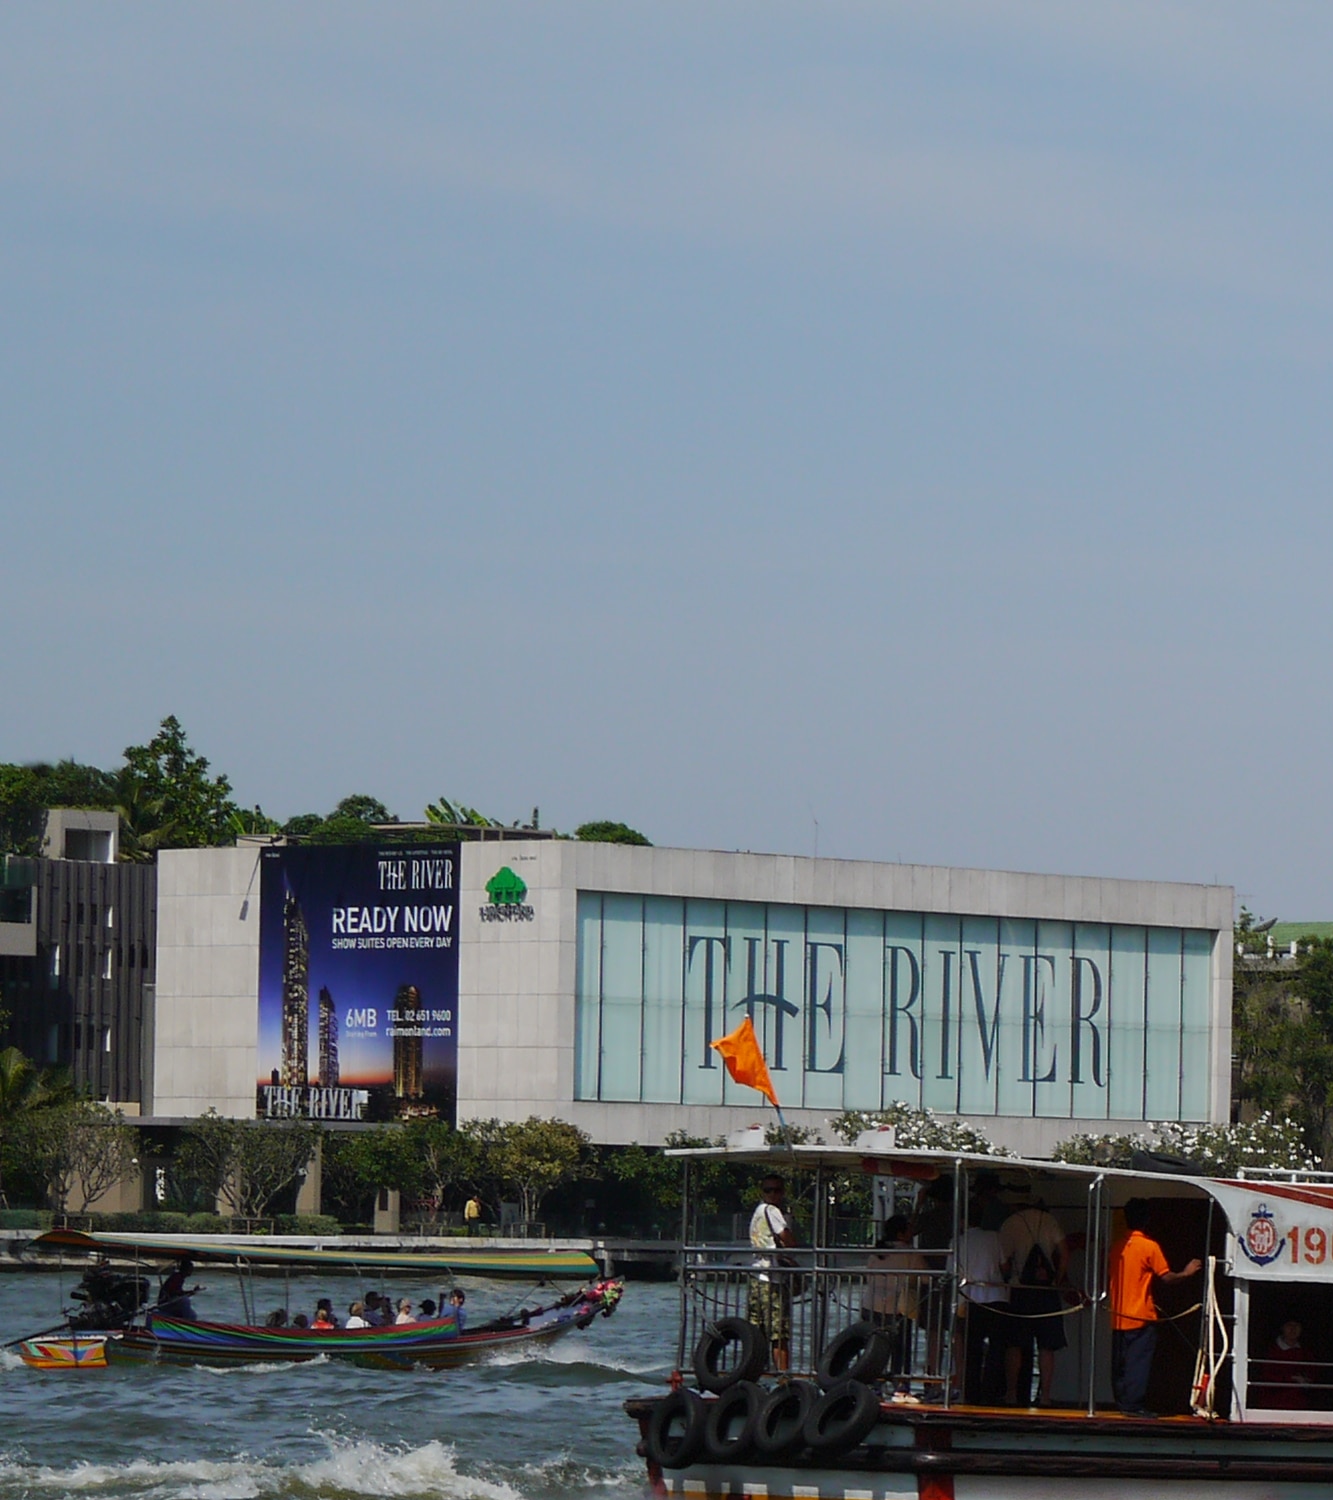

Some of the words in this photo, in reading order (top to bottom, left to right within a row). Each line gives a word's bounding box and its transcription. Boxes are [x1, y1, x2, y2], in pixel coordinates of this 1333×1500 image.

[378, 860, 407, 890] THE
[411, 859, 453, 890] RIVER
[331, 906, 399, 934] READY
[404, 905, 453, 933] NOW
[331, 937, 356, 949] SHOW
[357, 937, 385, 949] SUITES
[386, 937, 408, 948] OPEN
[409, 937, 434, 948] EVERY
[435, 936, 452, 948] DAY
[345, 1008, 377, 1028] 6MB
[386, 1009, 404, 1021] TEL.
[431, 1009, 452, 1021] 9600
[688, 935, 846, 1074] THE
[882, 945, 1107, 1088] RIVER
[385, 1025, 452, 1037] raimonland.com
[264, 1085, 303, 1118] THE
